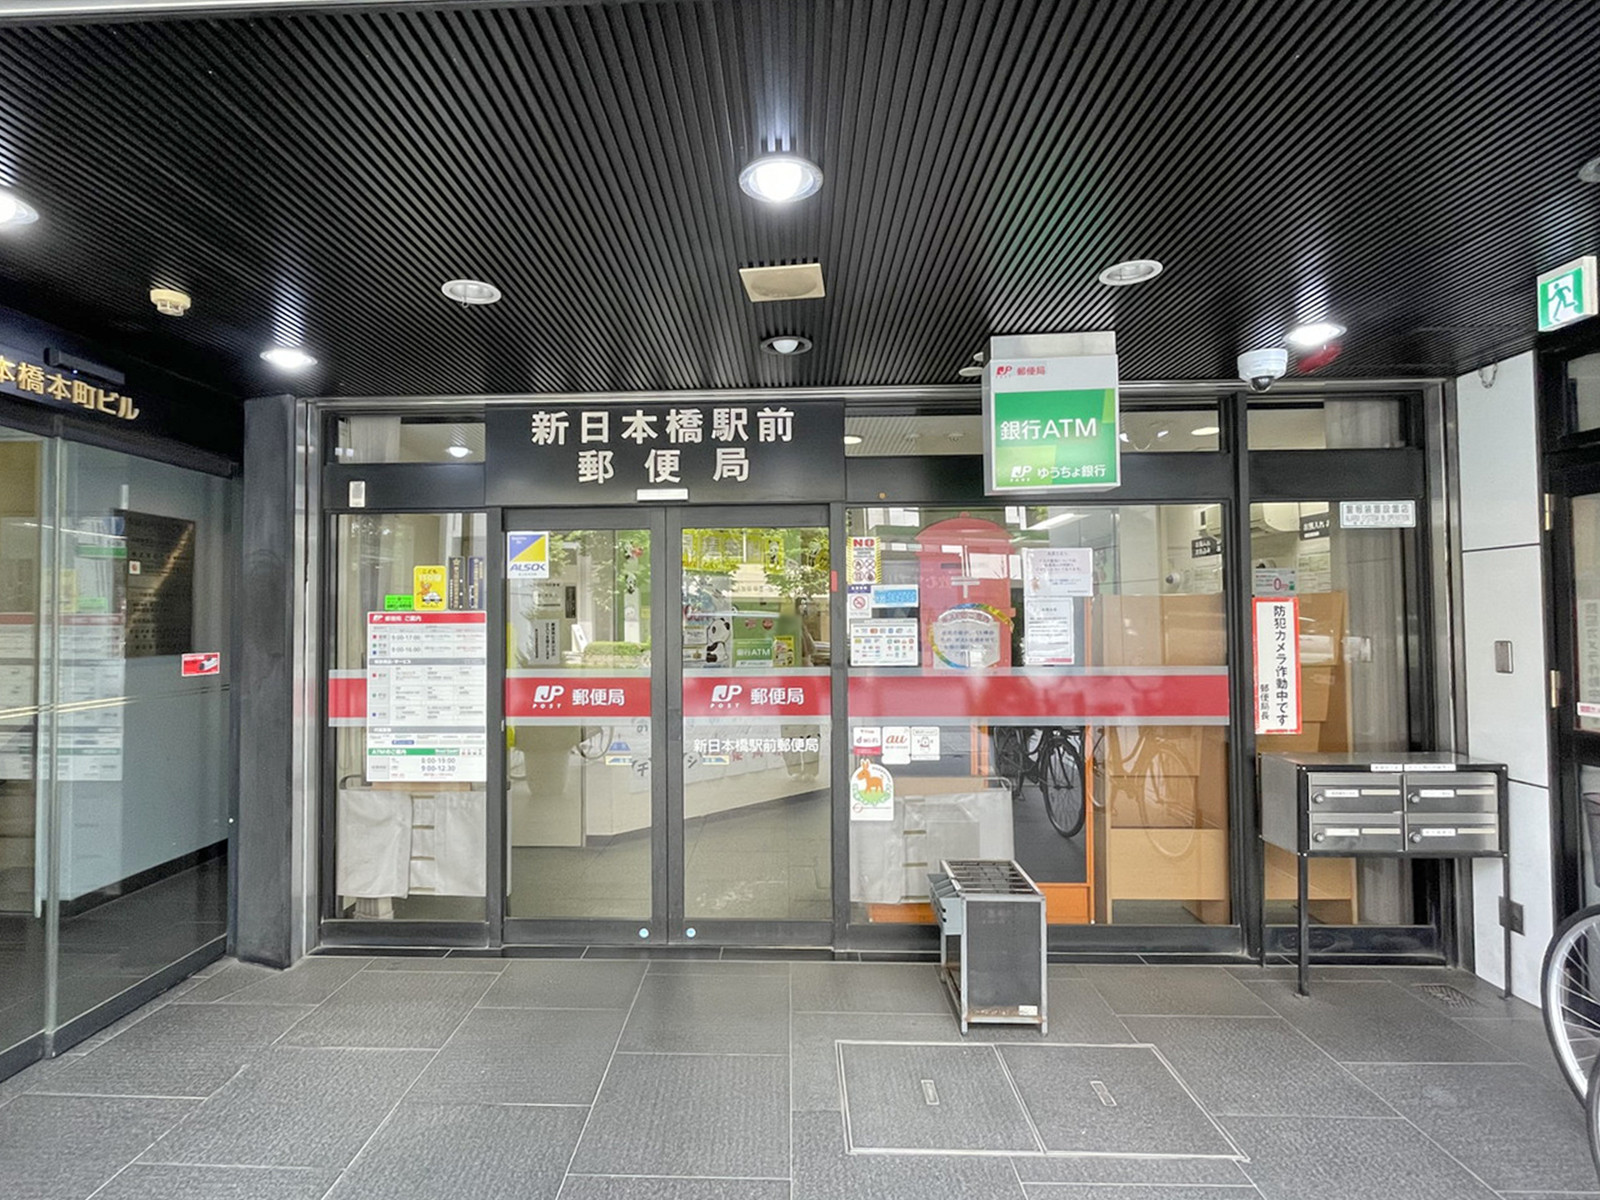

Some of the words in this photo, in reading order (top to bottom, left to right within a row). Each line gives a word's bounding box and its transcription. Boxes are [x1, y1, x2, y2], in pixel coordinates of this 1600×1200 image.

[1017, 366, 1046, 376] 郵便局
[531, 407, 795, 446] 新日本橋駅前
[1000, 417, 1097, 440] 銀行ATM
[578, 448, 750, 484] 郵便局
[1037, 464, 1107, 479] ゆうちょ銀行
[853, 538, 875, 547] NO
[509, 563, 546, 572] ALSOK
[1273, 605, 1289, 726] 防犯カメラ作動中です
[572, 688, 625, 706] 郵便局
[750, 687, 804, 705] 郵便局
[1260, 683, 1270, 720] 郵便局長
[694, 738, 819, 753] 新日本橋駅前郵便局
[886, 735, 908, 744] au
